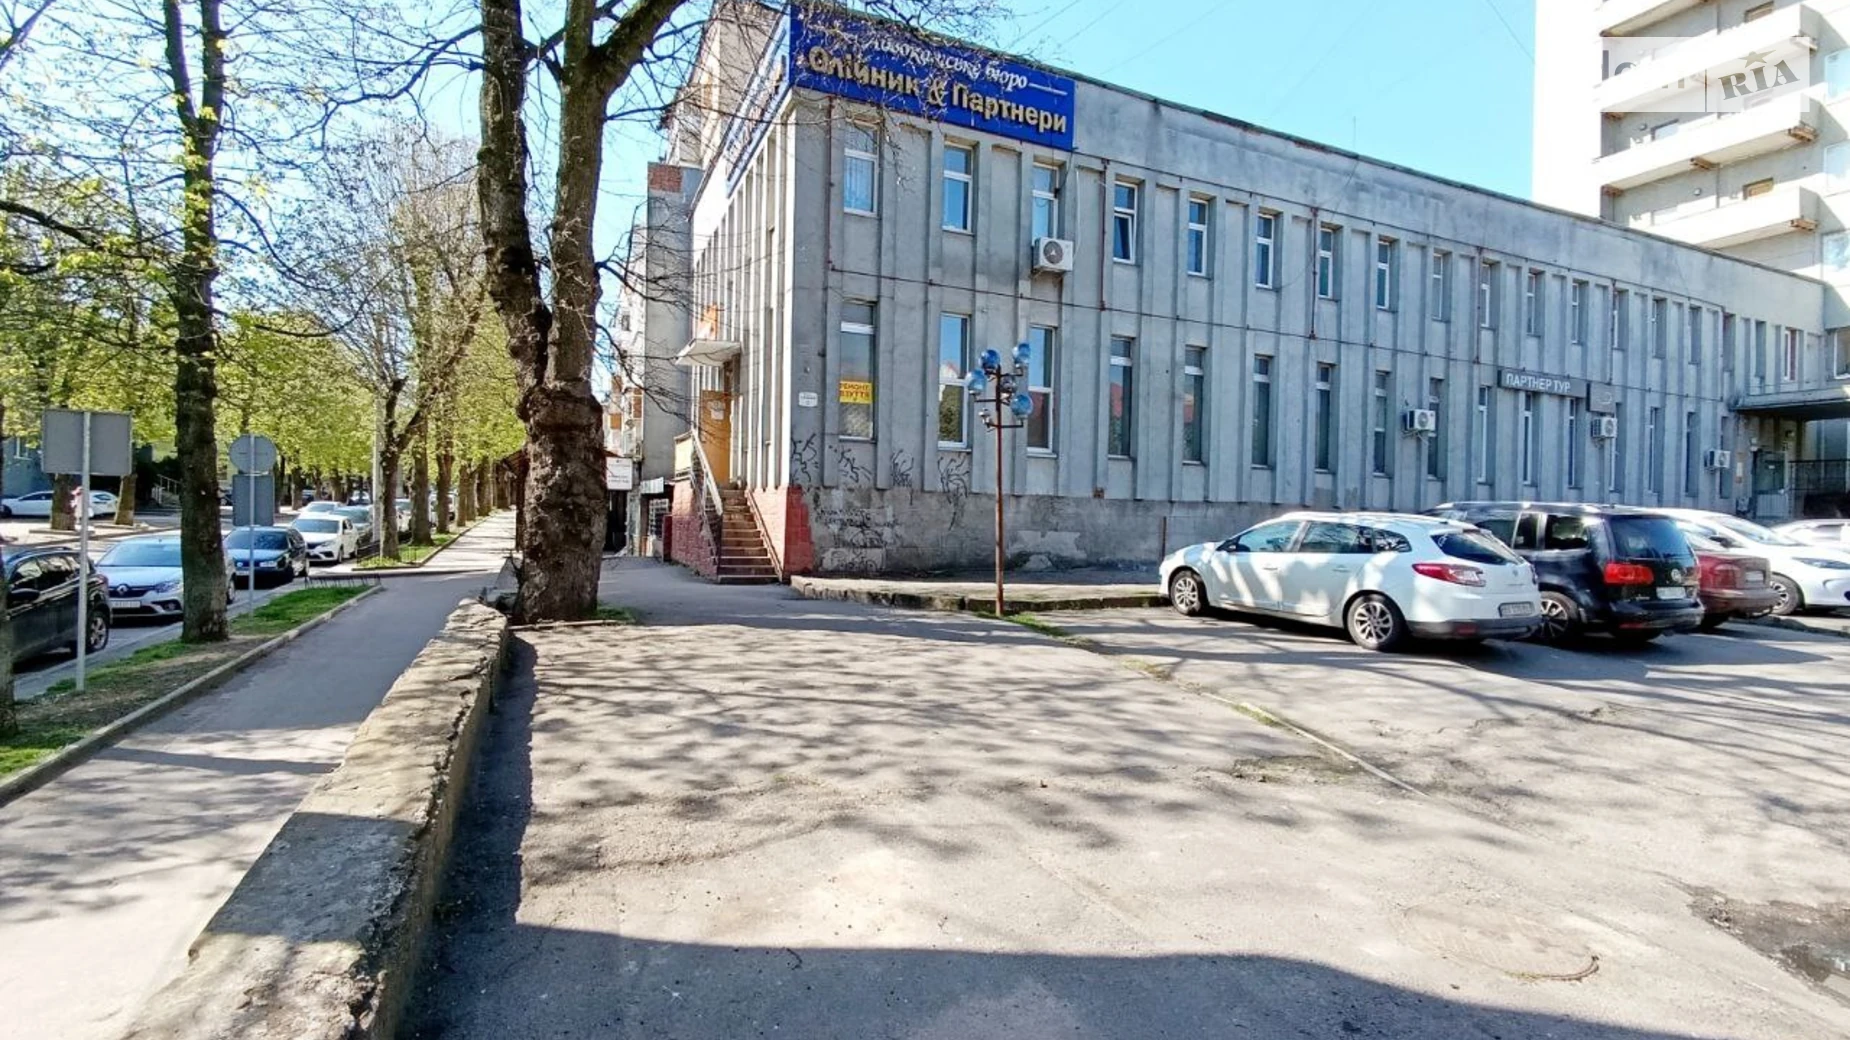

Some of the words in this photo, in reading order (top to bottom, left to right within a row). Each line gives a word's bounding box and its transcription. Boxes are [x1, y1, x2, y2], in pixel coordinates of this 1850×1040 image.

[808, 45, 920, 97] Олійник
[927, 77, 950, 107] &
[952, 83, 1067, 133] Партнери
[985, 59, 1028, 92] бюро
[1506, 373, 1552, 390] ПАРТНЕР
[1553, 380, 1570, 393] ТУР
